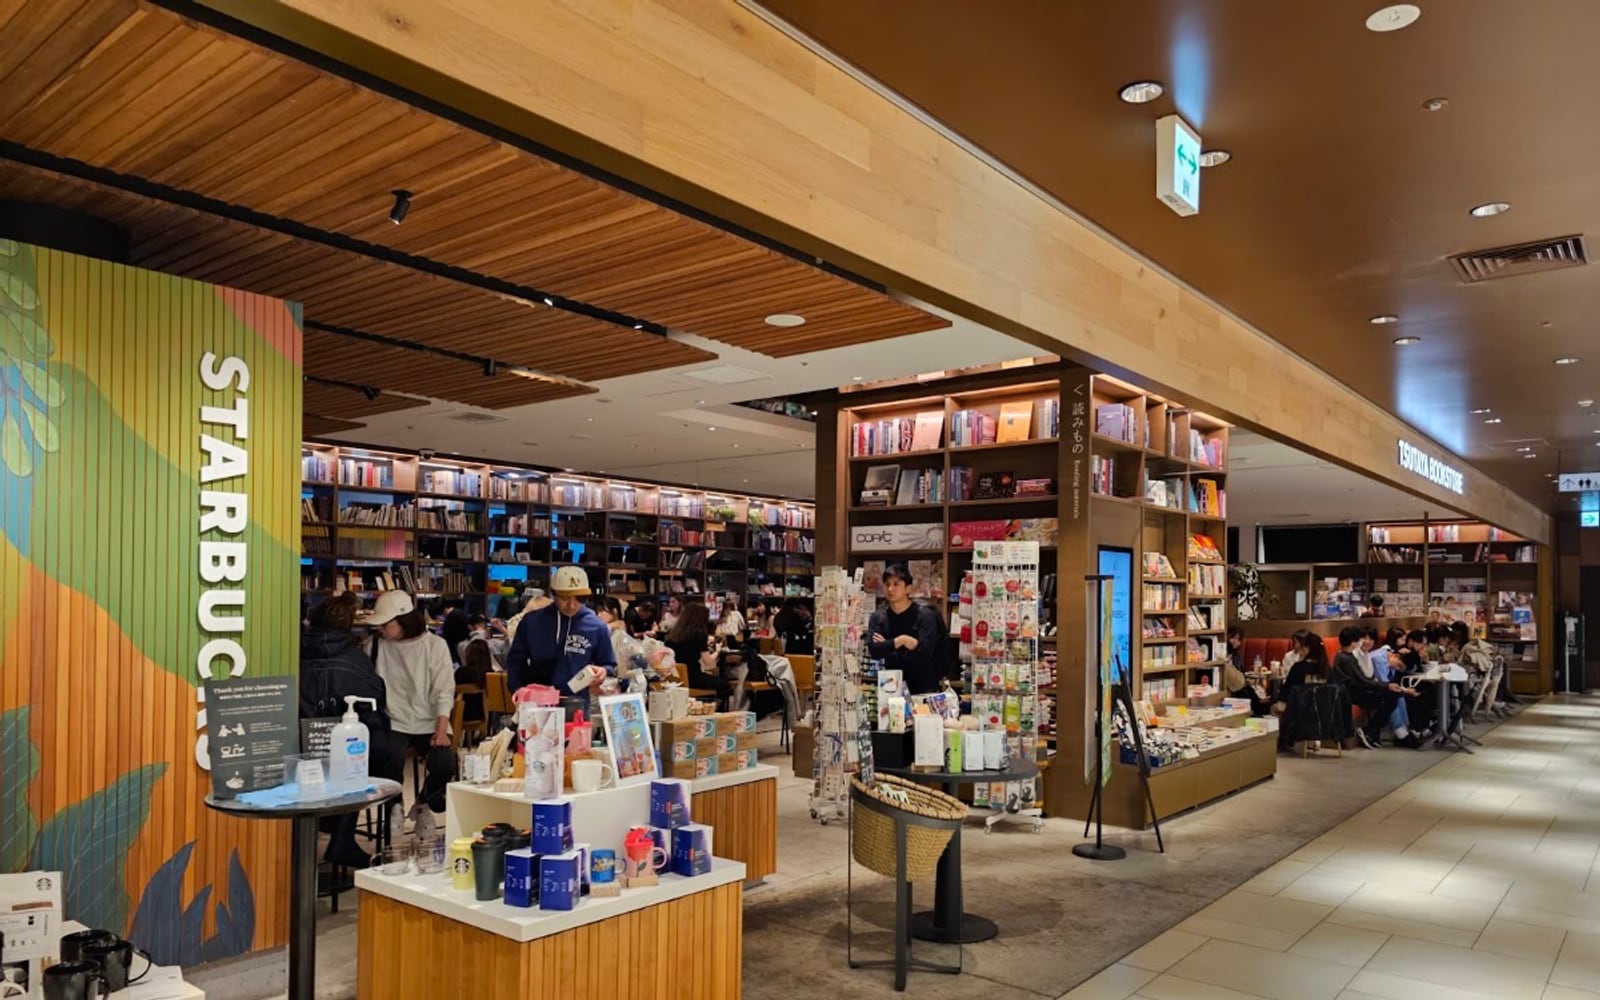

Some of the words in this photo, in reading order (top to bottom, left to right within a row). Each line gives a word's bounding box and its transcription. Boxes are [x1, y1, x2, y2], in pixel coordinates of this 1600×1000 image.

[1071, 402, 1085, 455] 読みもの
[195, 351, 250, 771] STARBUC
